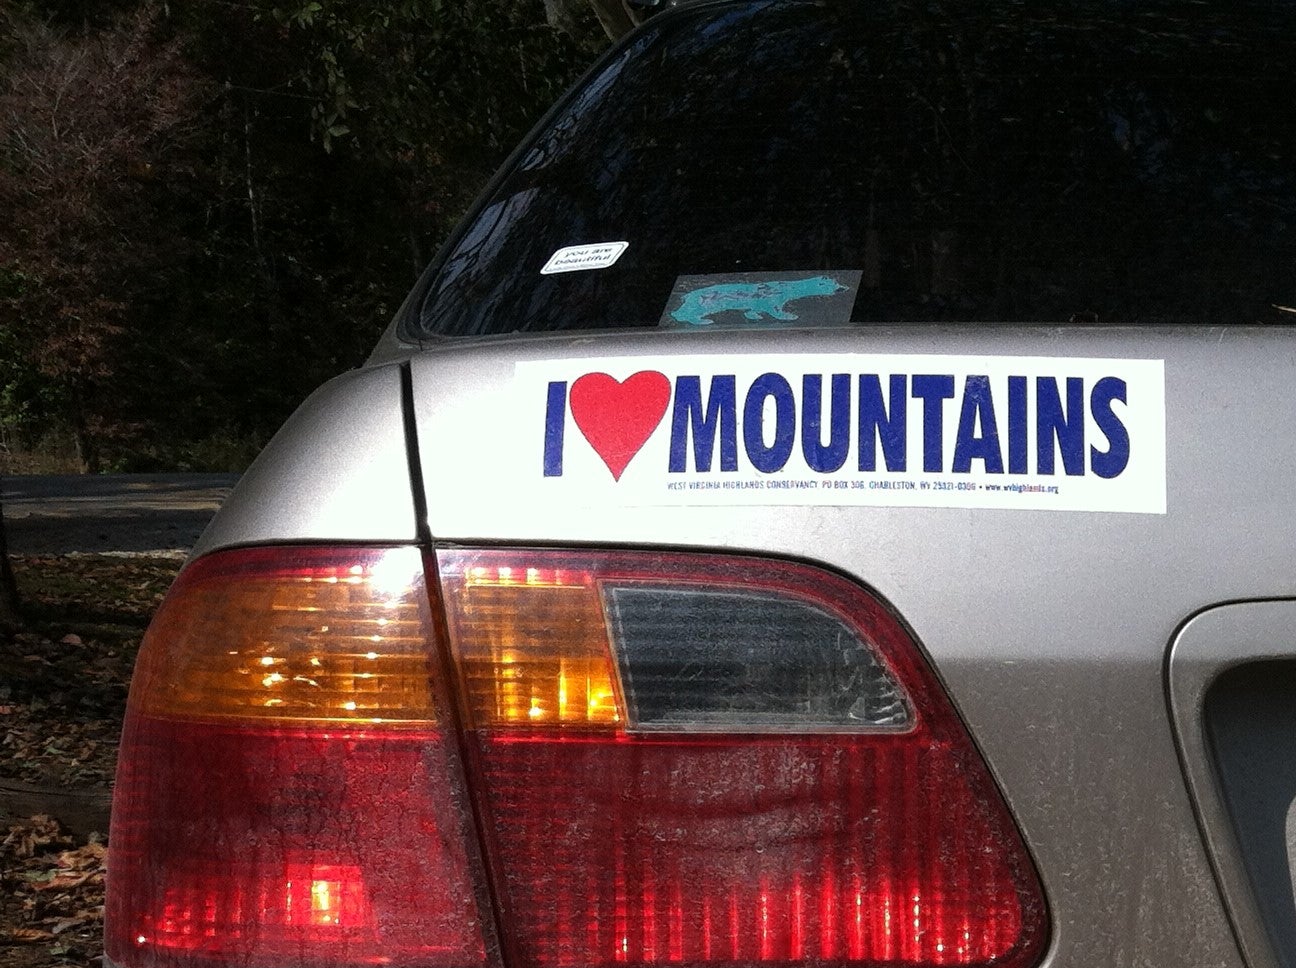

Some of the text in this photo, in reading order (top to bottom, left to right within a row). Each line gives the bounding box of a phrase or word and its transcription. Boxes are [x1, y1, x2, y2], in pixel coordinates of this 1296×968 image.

[565, 250, 589, 258] you
[554, 254, 612, 265] beautiful
[543, 371, 1131, 478] I MOUNTAINS
[667, 481, 687, 490] WEST
[766, 481, 818, 490] CONSERVANCY
[834, 481, 848, 490] BOX
